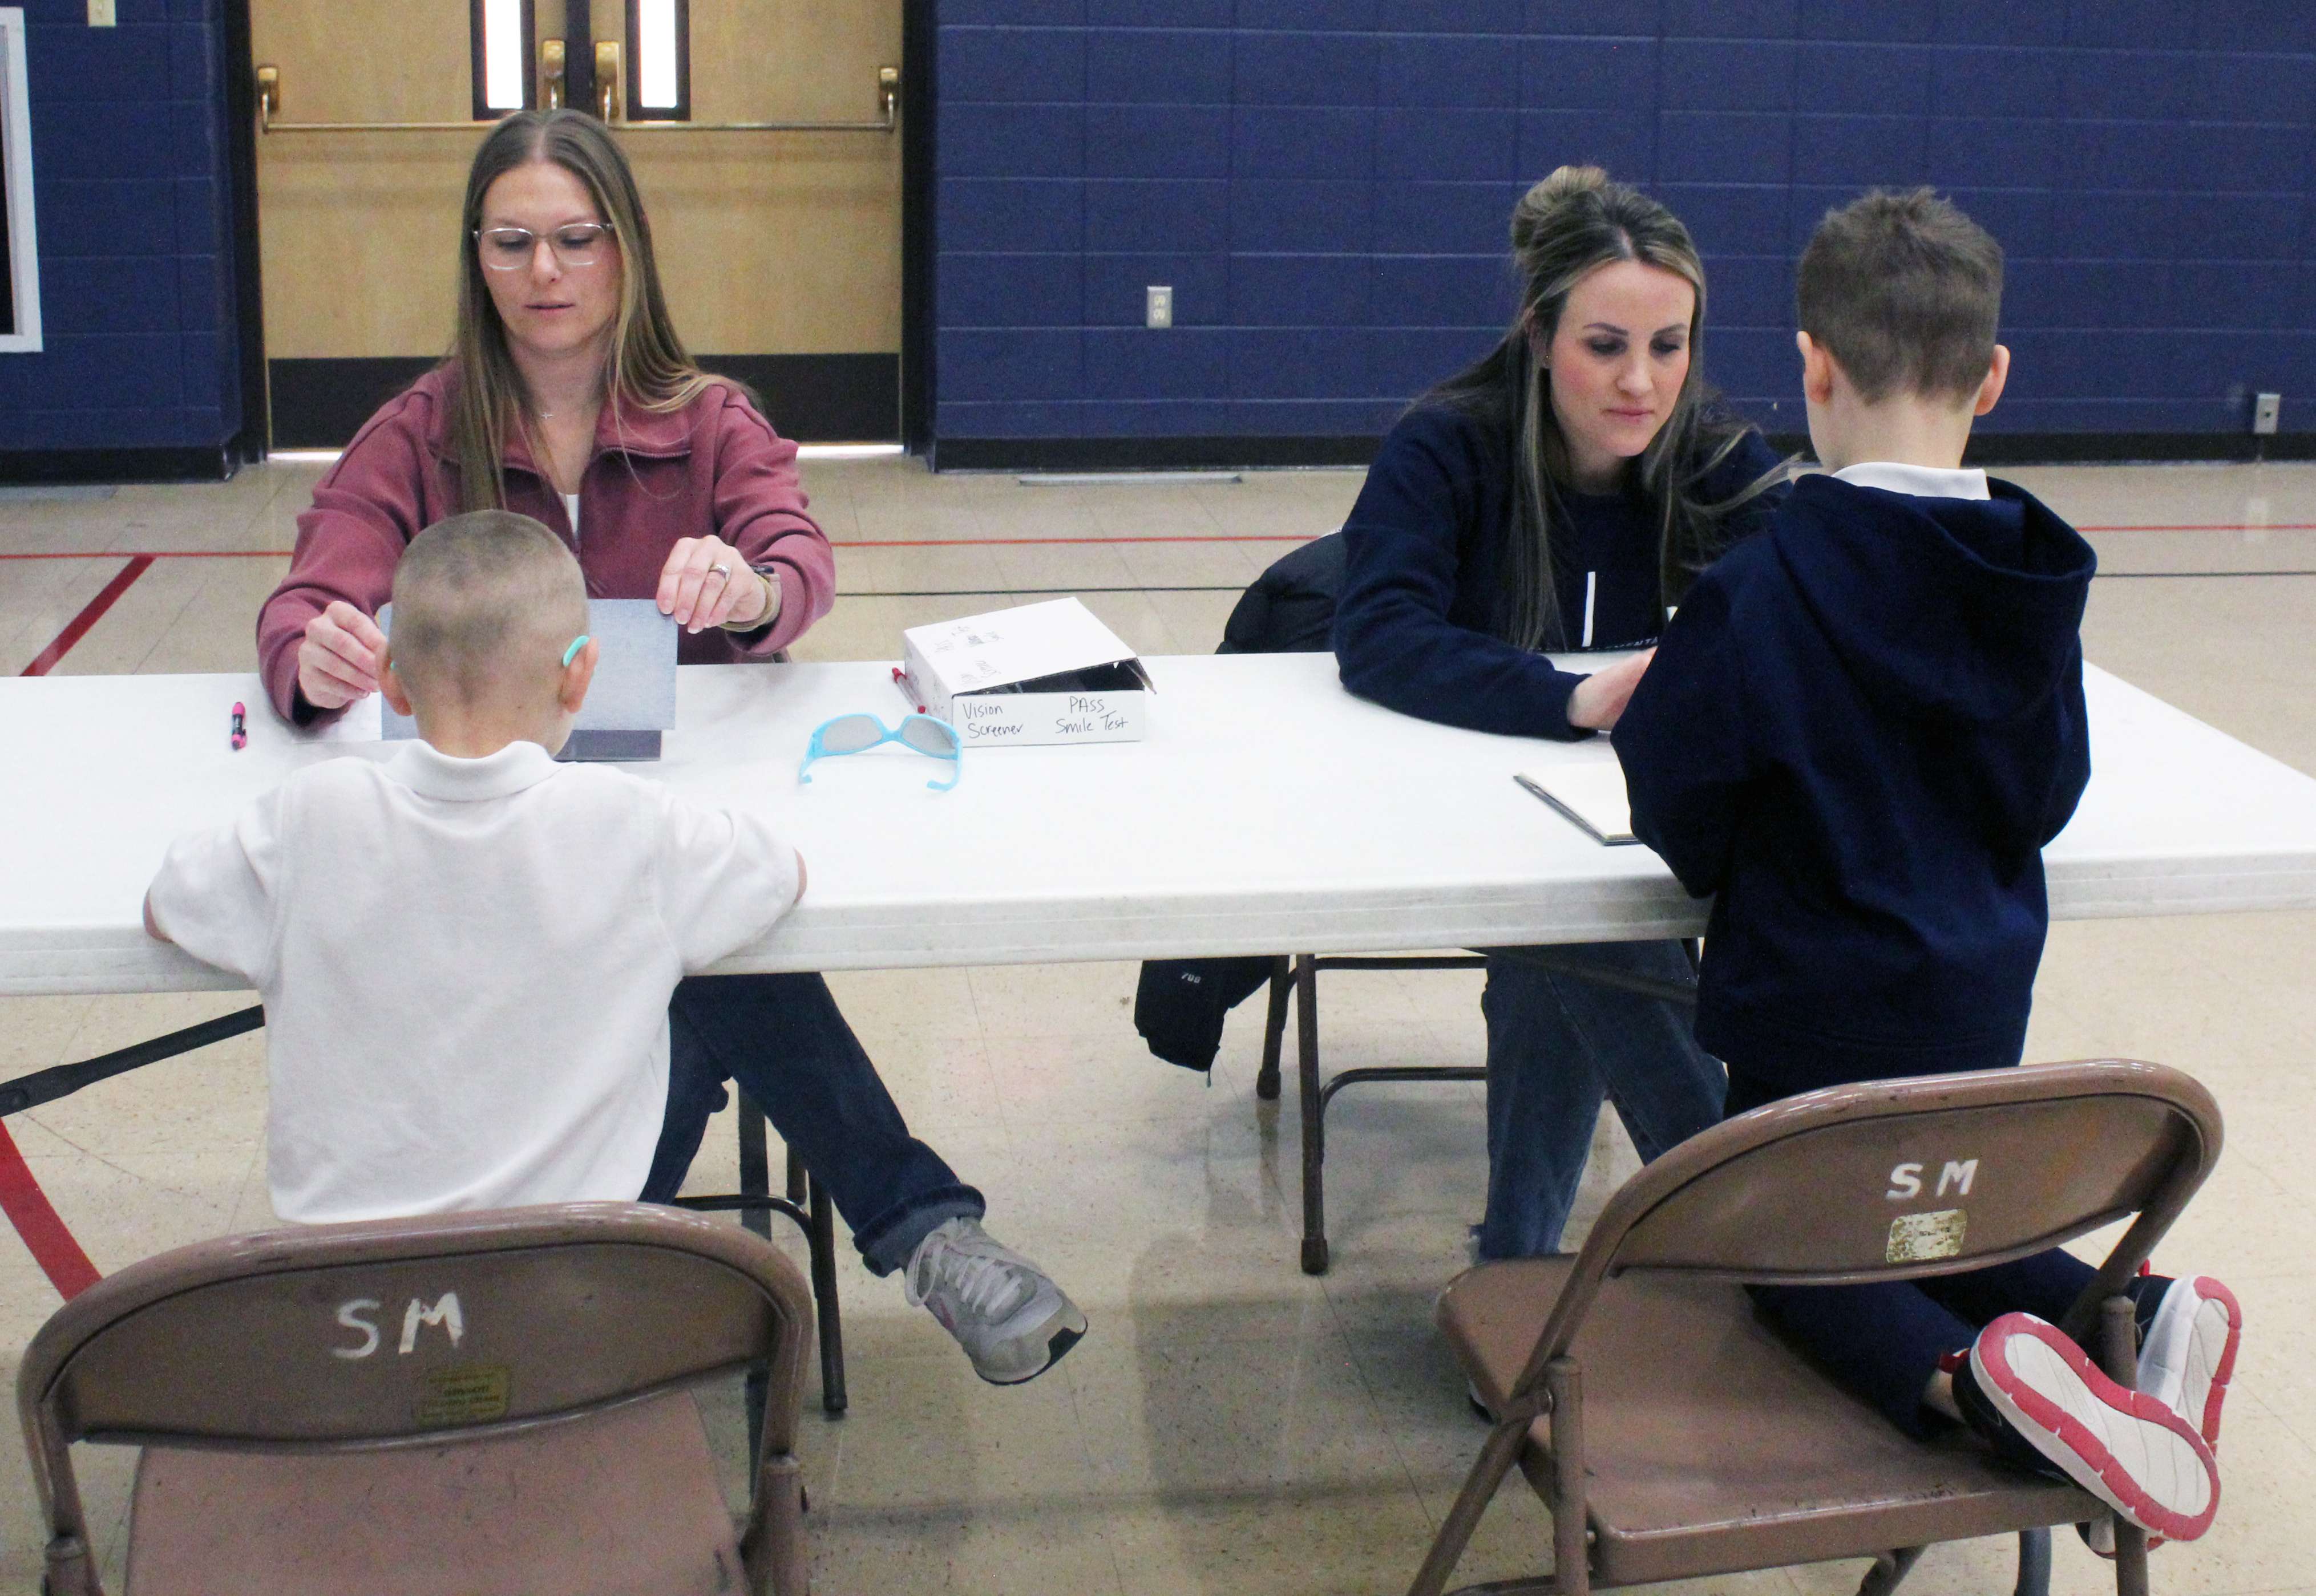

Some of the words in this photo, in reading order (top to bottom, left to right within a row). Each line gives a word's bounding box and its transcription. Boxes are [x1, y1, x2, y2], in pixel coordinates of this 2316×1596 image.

[963, 703, 1003, 719] Vision
[1069, 695, 1105, 713] PASS
[968, 723, 1024, 739] Screener
[1055, 716, 1094, 735] Smile
[1099, 710, 1129, 730] Test
